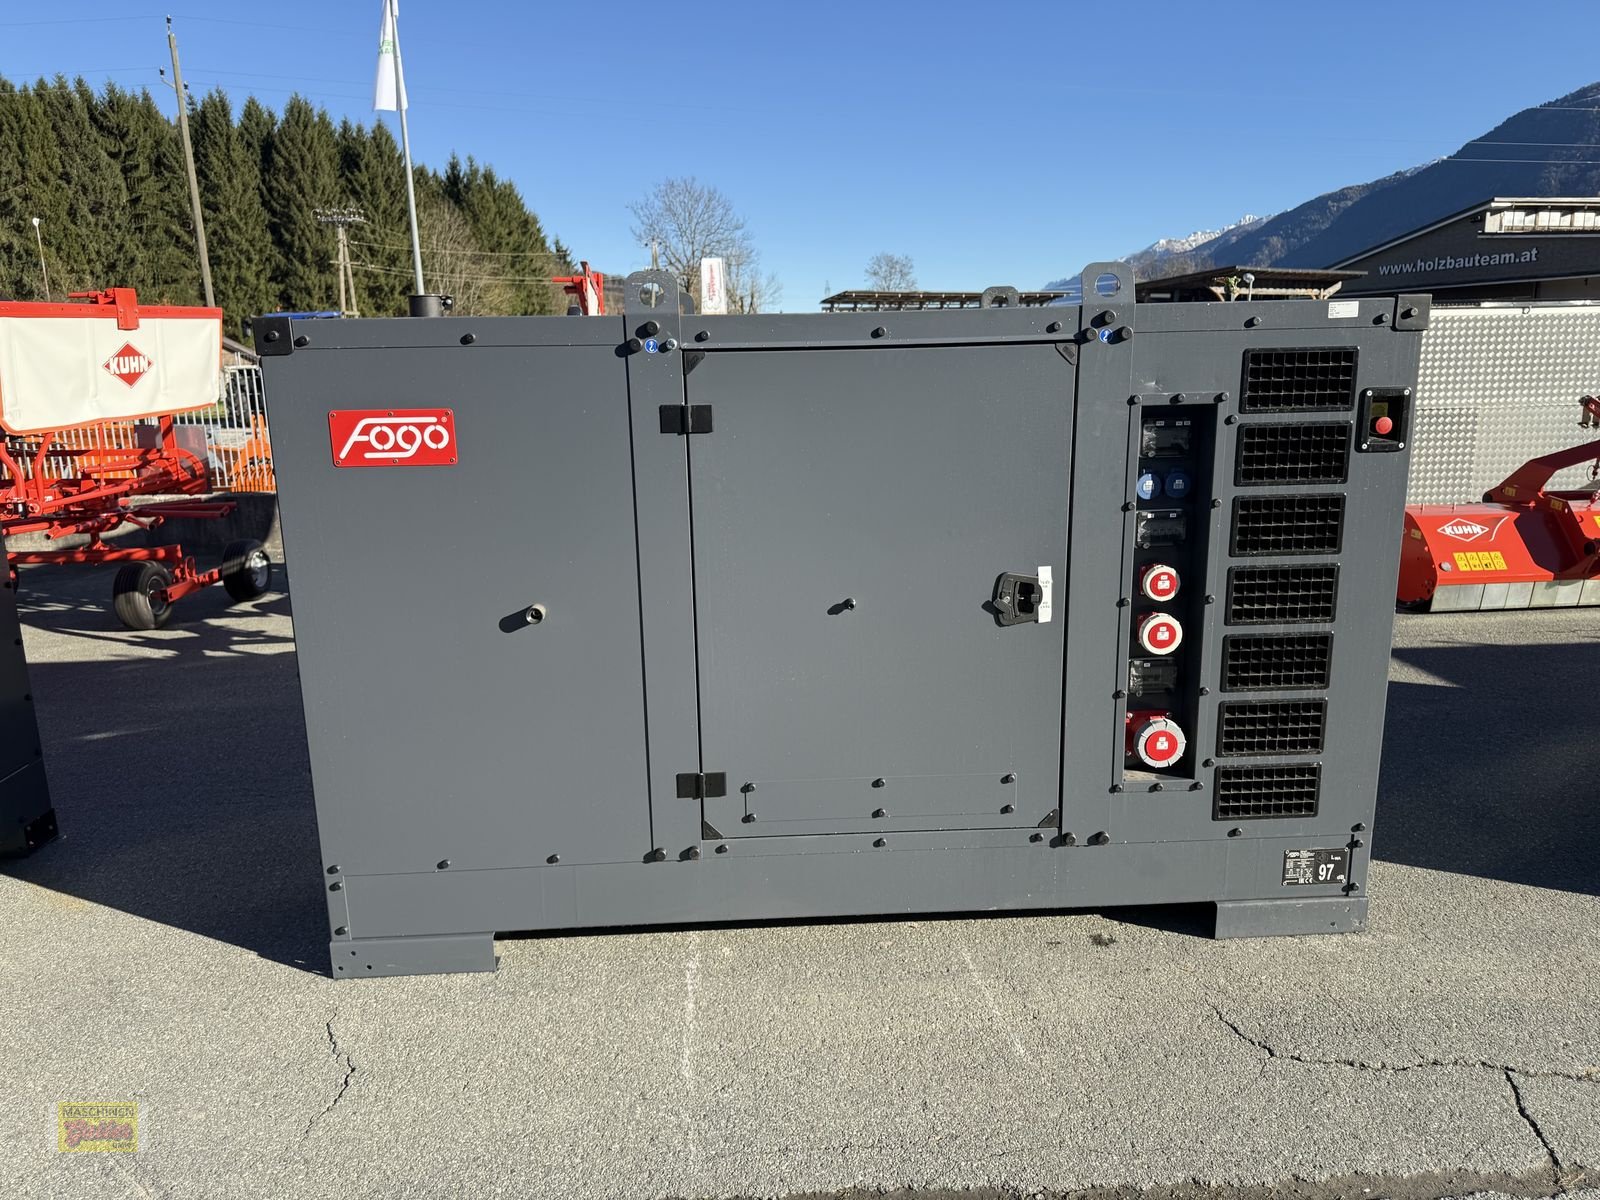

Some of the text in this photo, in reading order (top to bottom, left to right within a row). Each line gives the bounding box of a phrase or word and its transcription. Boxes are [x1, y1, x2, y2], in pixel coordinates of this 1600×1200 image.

[1379, 247, 1538, 275] www.holzbauteam.at
[109, 355, 149, 375] KUHN
[1444, 525, 1482, 535] KUHN
[1318, 863, 1335, 881] 97
